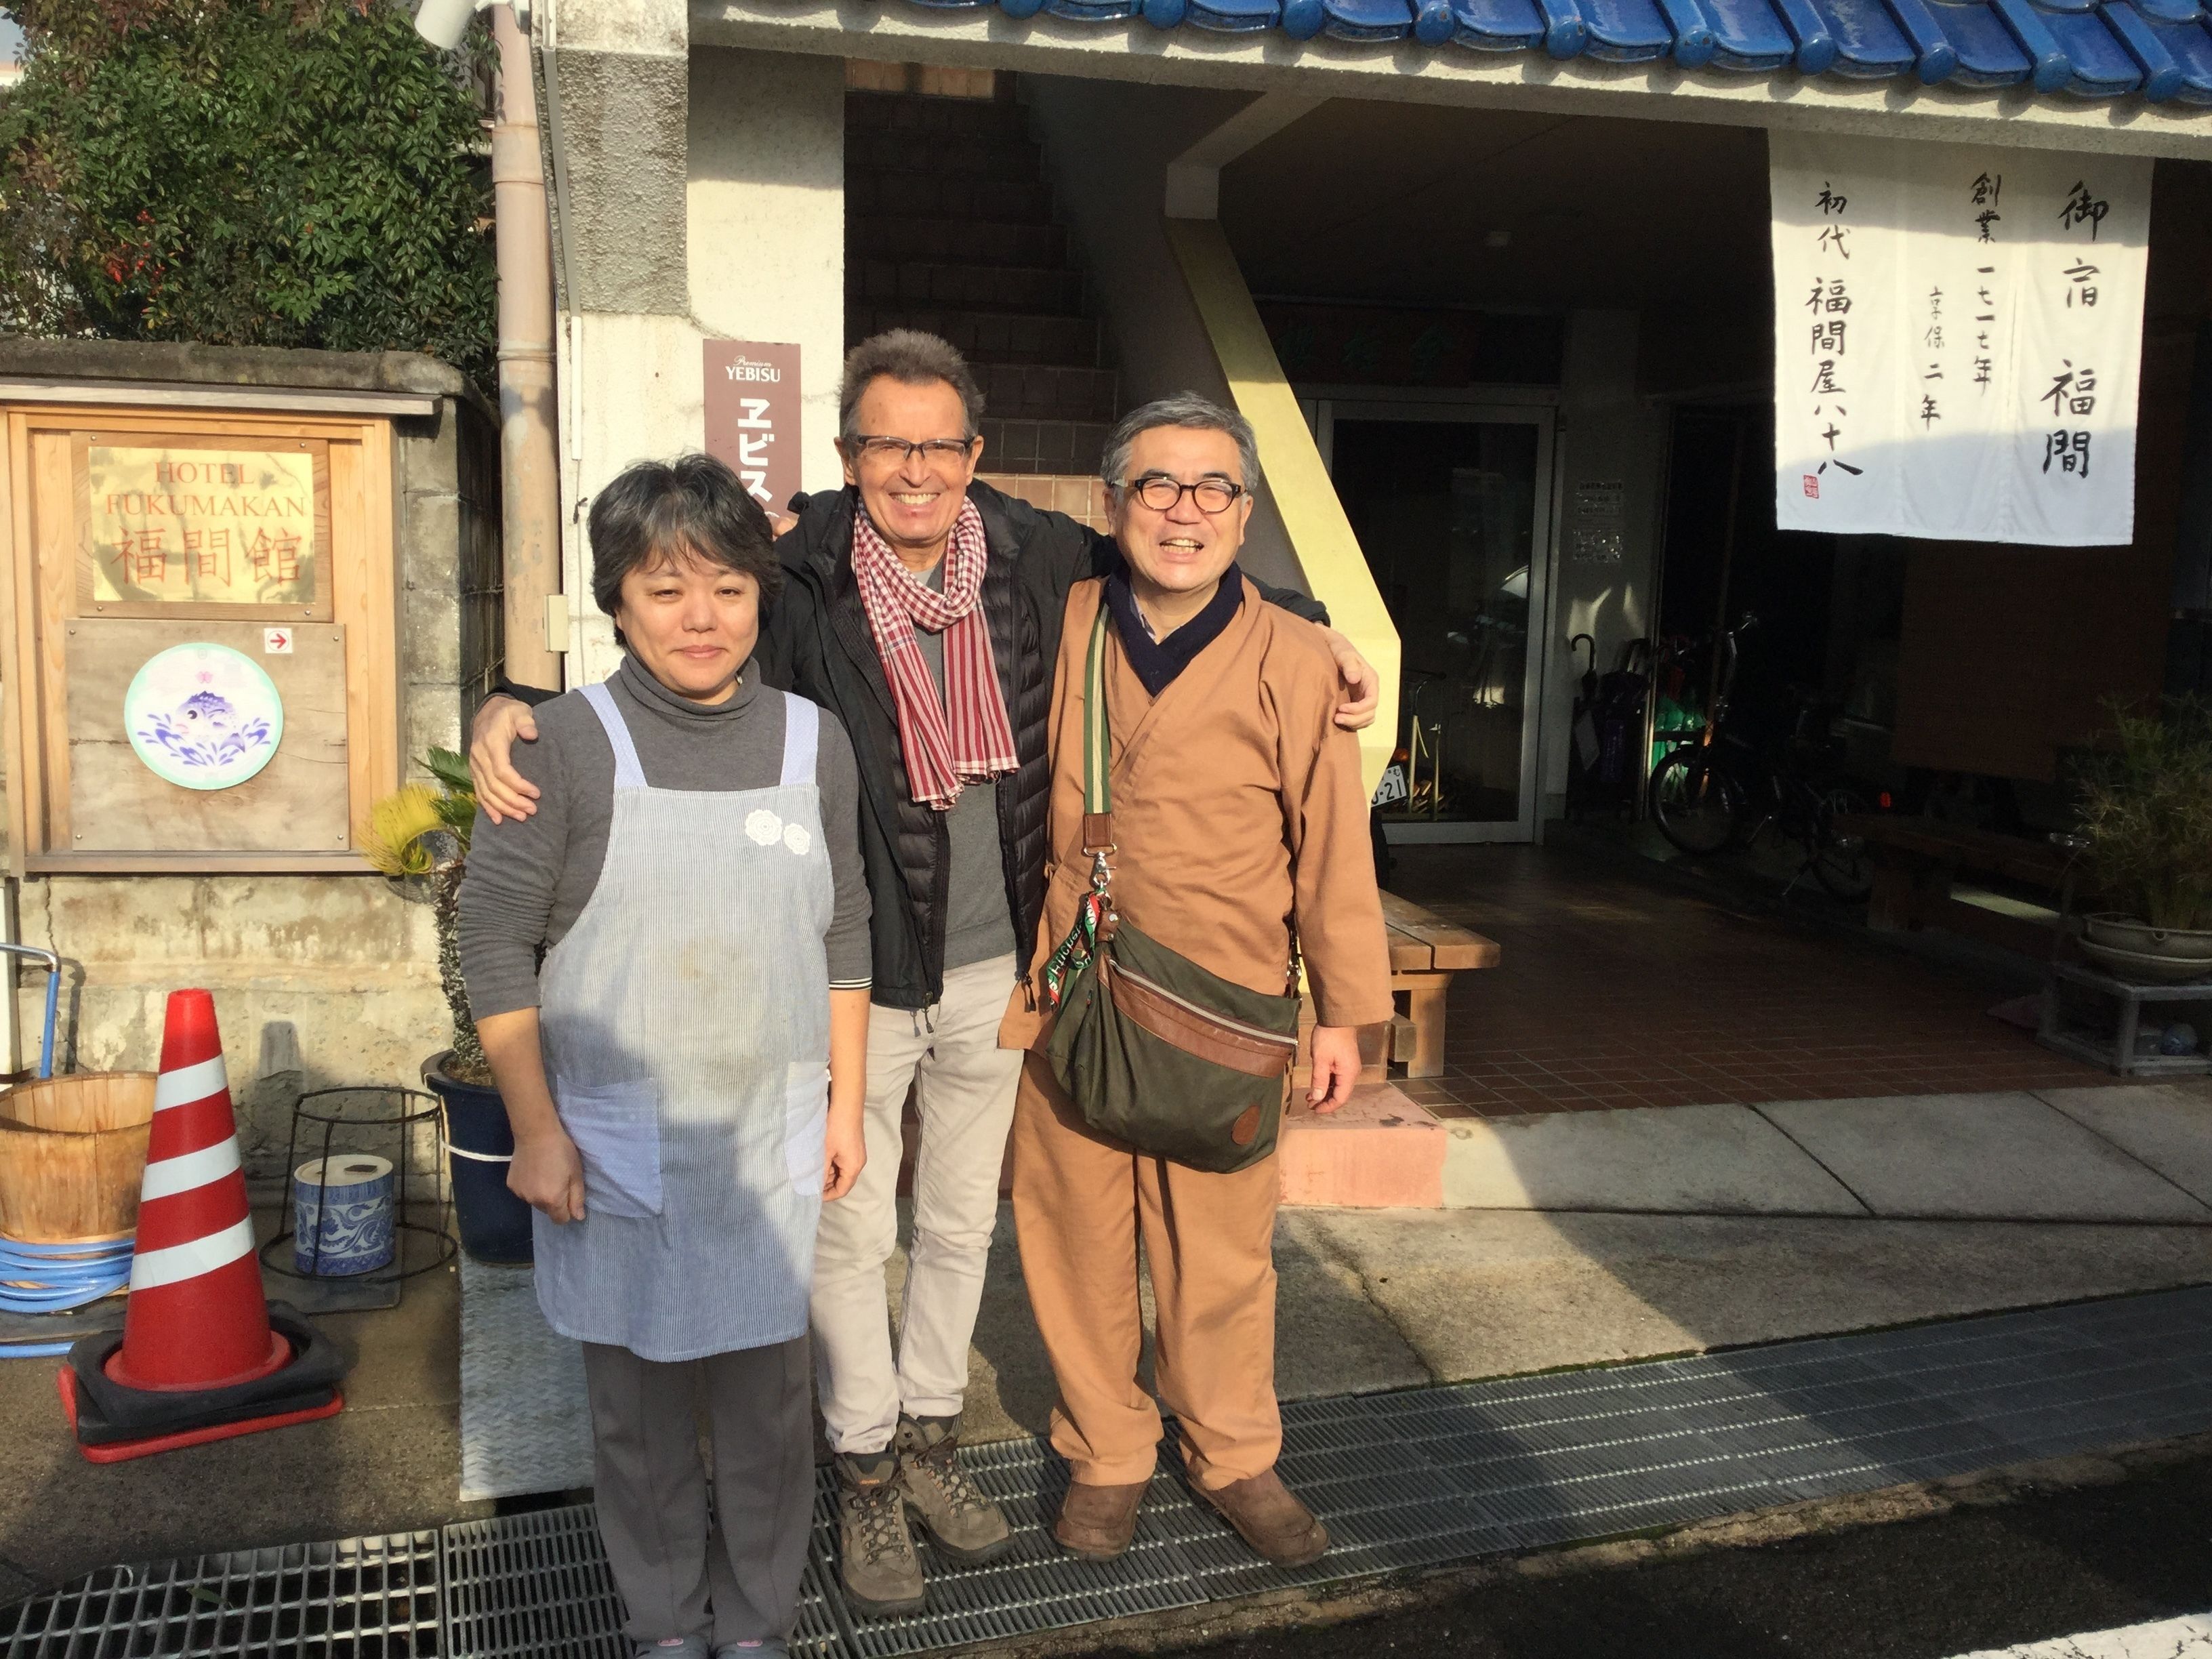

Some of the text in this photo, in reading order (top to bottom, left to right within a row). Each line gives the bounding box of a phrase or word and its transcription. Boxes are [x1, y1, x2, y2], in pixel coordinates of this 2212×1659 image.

[733, 354, 773, 367] Premium
[725, 365, 781, 382] YEBISU
[155, 462, 255, 485] HOTEL
[106, 493, 308, 518] FUKUMAKAN
[110, 526, 302, 588] 福間館
